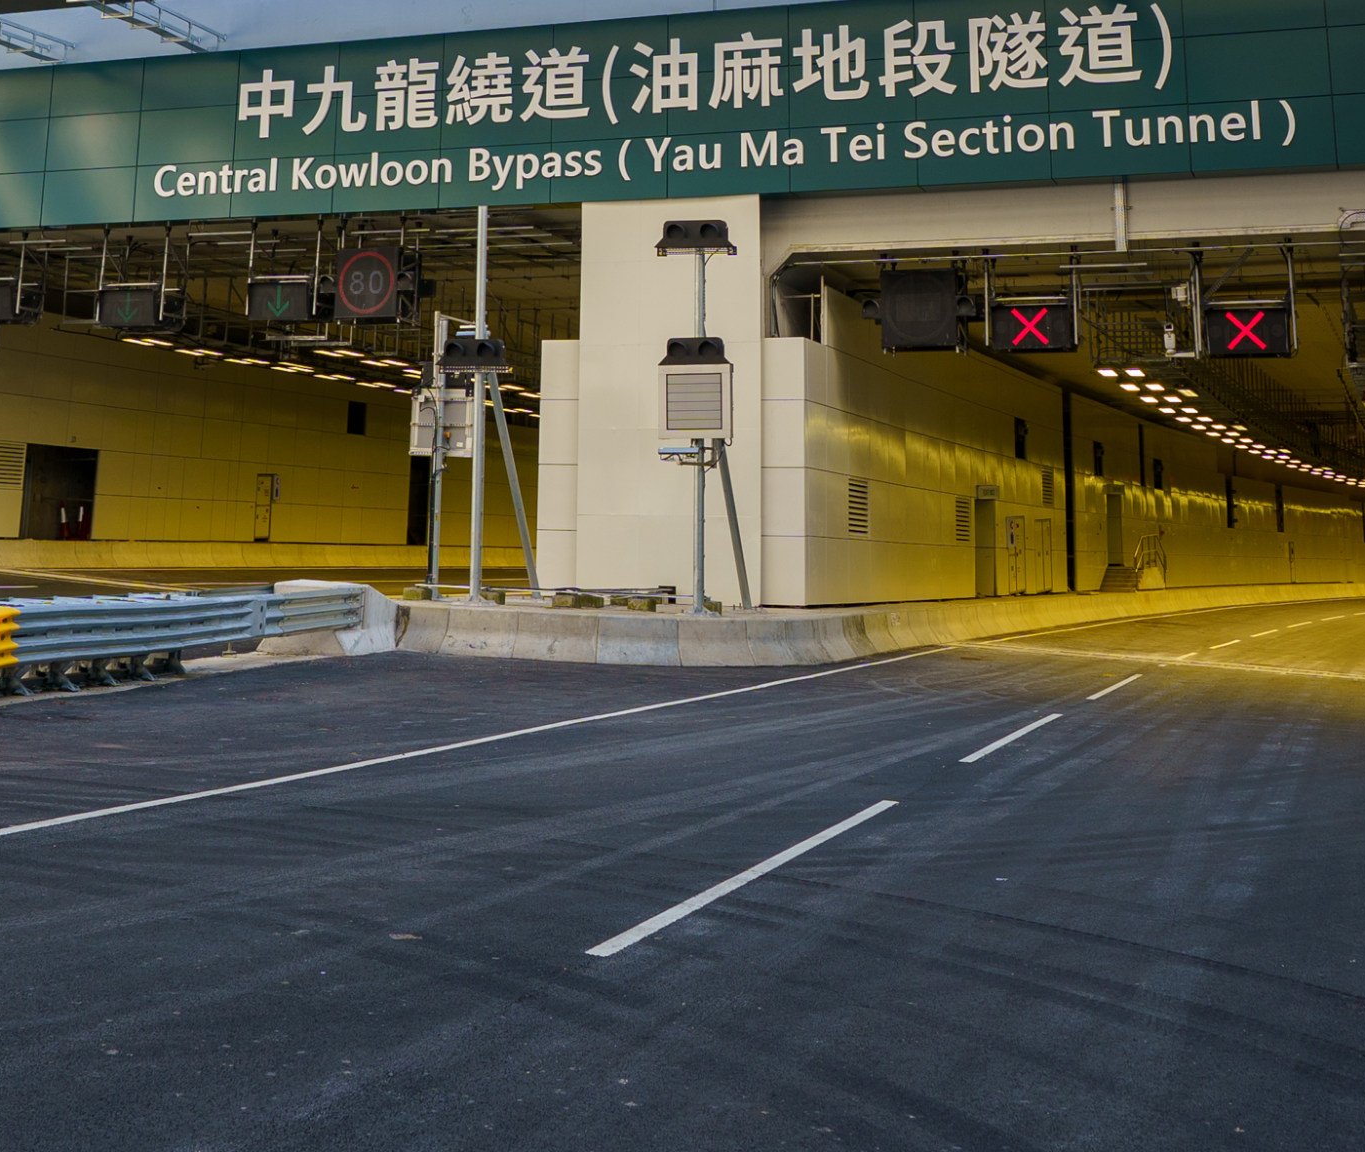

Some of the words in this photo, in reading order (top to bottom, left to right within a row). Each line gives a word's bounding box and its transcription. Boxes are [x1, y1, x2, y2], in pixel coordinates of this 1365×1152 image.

[238, 3, 1172, 139] 中九龍繞道(油麻地段隧道)
[153, 157, 278, 198] Central
[291, 151, 453, 191] Kowloon
[468, 148, 603, 191] Bypass
[740, 130, 805, 168] Ma
[820, 126, 885, 162] Tei
[904, 115, 1075, 159] Section
[1092, 99, 1262, 148] Tunnel
[349, 270, 384, 295] 80
